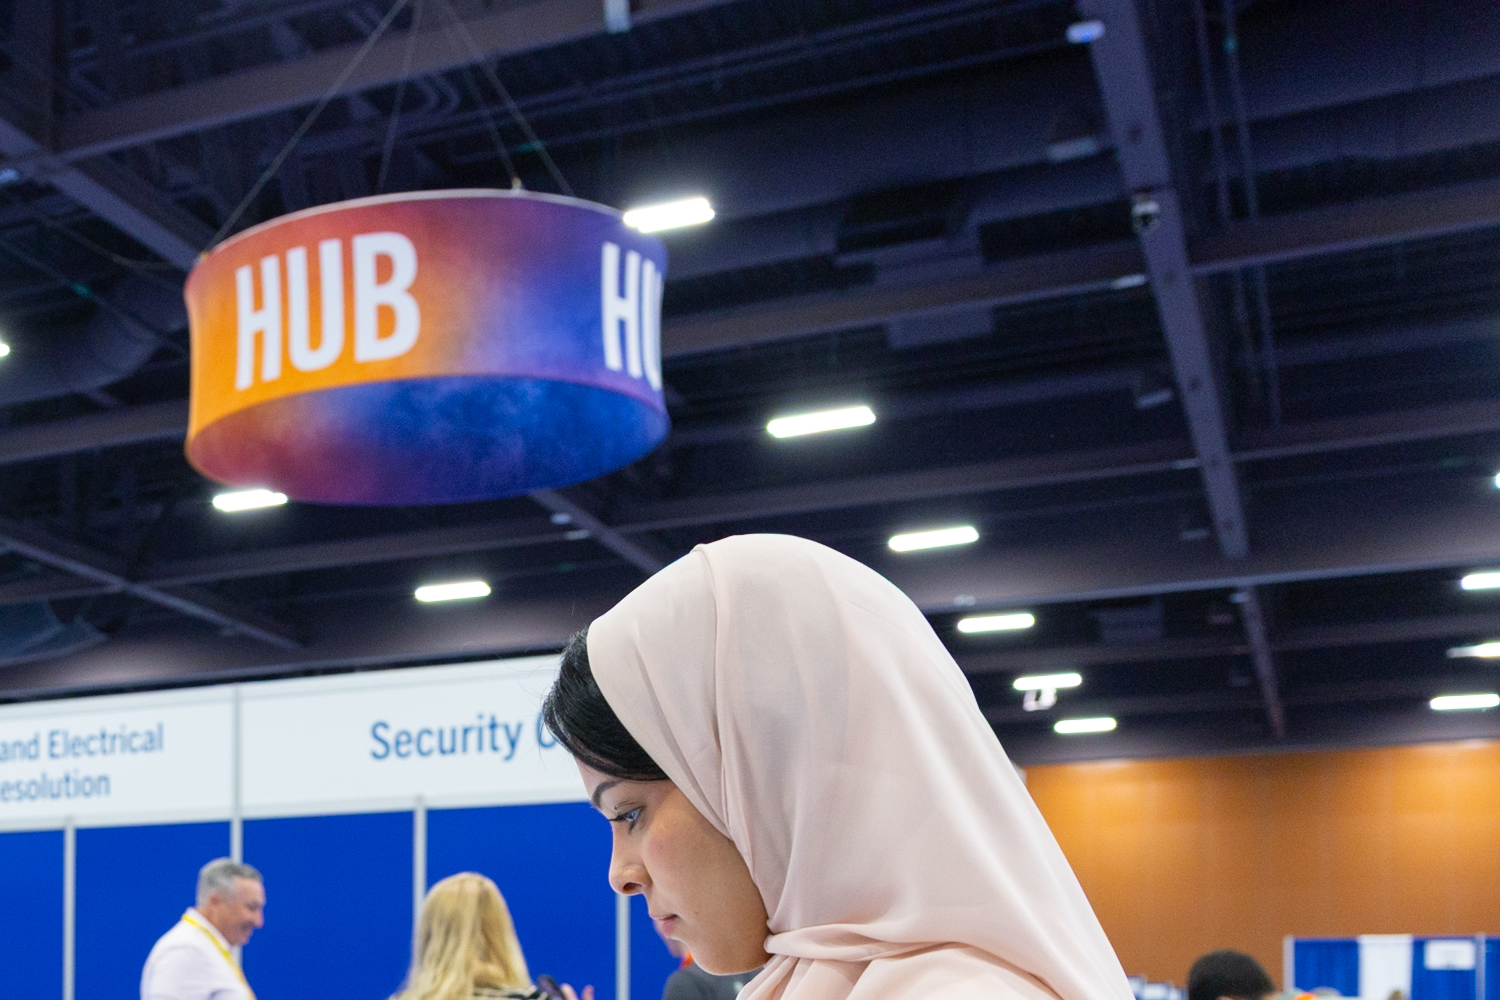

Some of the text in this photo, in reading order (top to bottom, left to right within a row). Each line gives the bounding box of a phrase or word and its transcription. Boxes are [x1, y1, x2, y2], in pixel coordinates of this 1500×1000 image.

[235, 231, 421, 392] HUB
[48, 722, 164, 760] Electrical
[370, 713, 523, 761] Security
